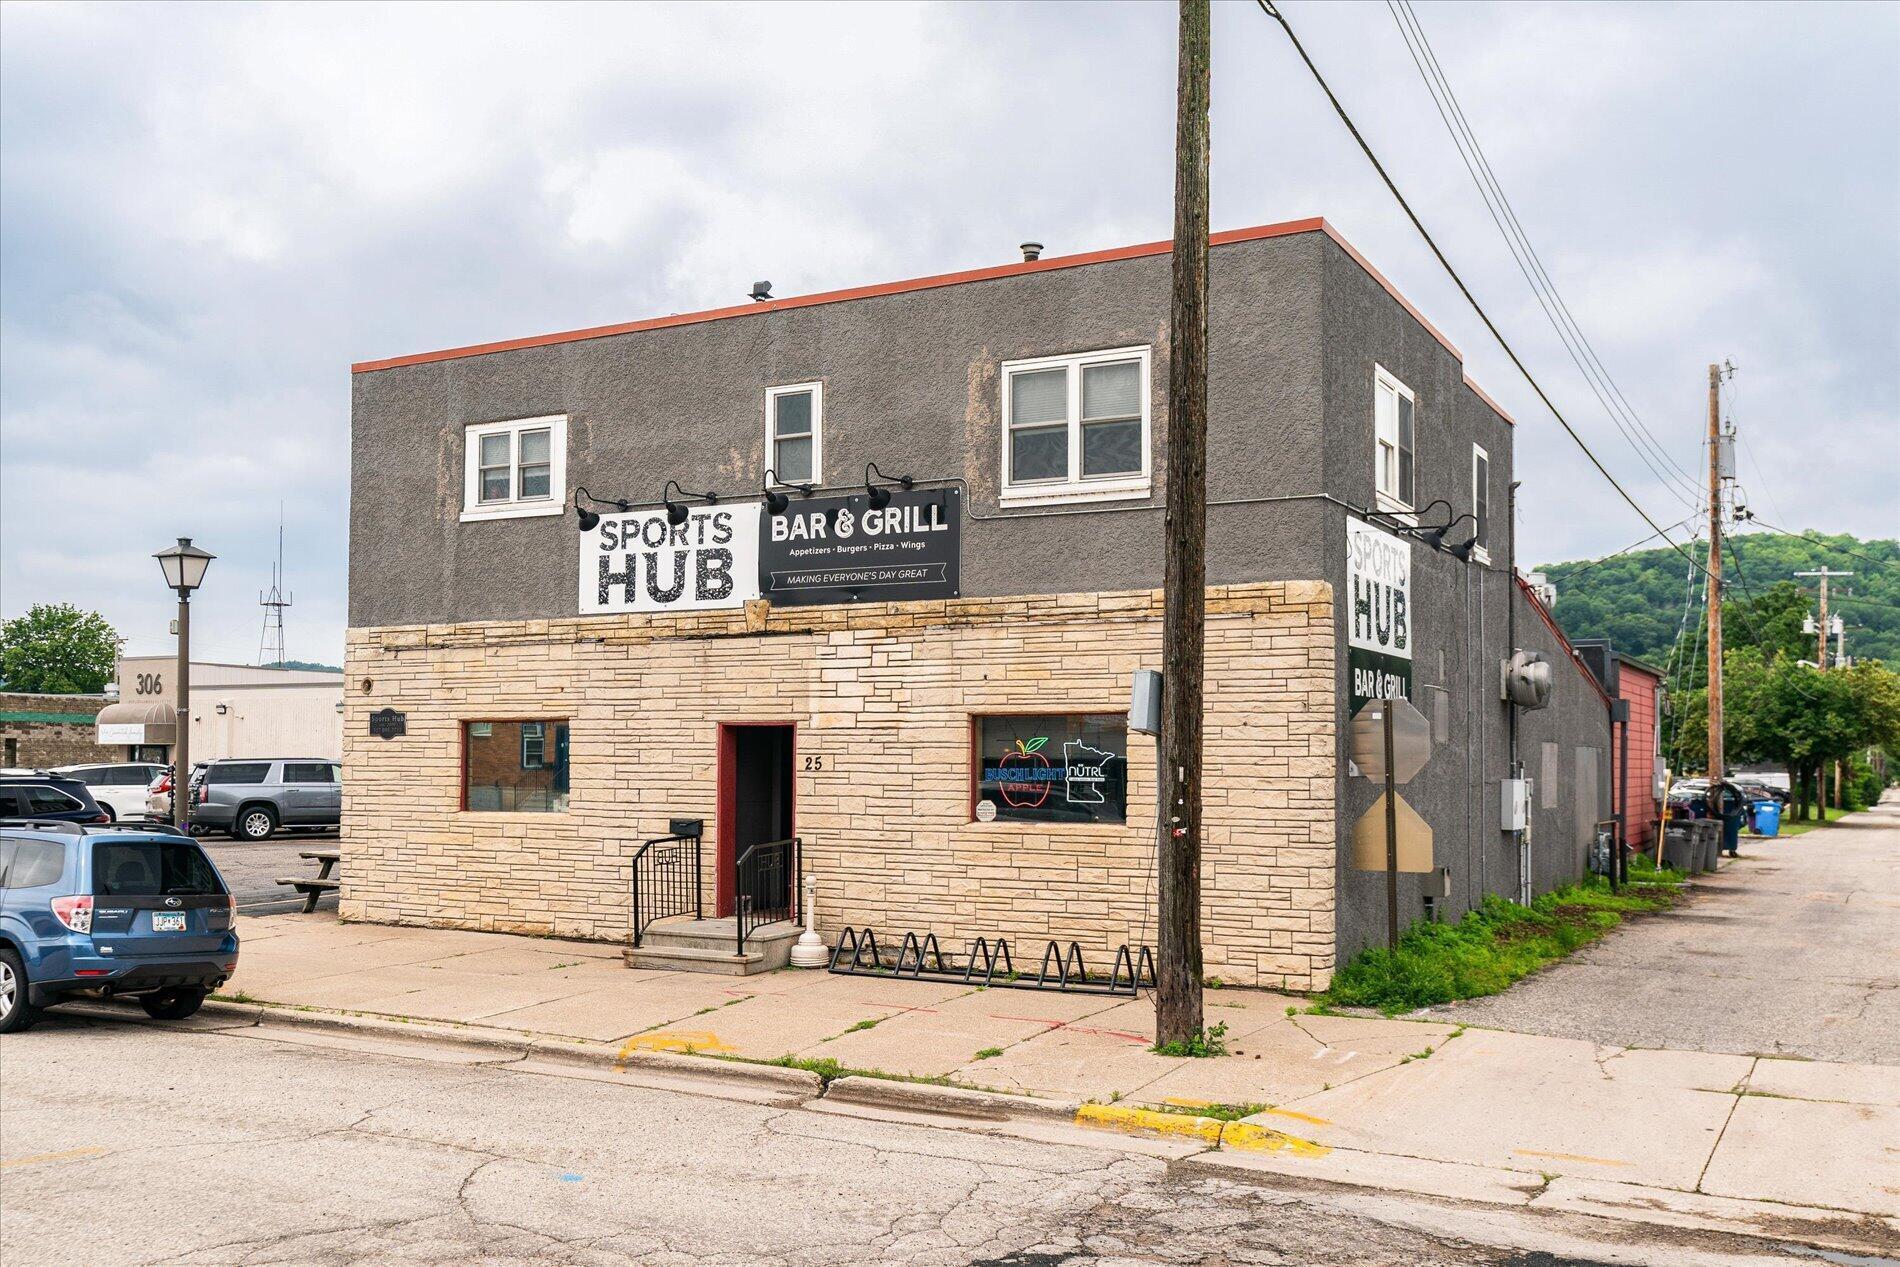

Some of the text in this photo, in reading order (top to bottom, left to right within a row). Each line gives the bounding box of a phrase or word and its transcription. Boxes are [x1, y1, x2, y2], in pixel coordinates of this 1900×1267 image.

[600, 512, 733, 551] SPORTS
[772, 504, 948, 541] BAR & GRILL
[789, 541, 926, 556] Appetizers Burgers Pizza Wings
[1354, 532, 1406, 587] SPORTS
[598, 548, 733, 605] HUB
[787, 568, 928, 584] MAKING EVERYONE'S DAY GREAT
[1354, 574, 1407, 650] HUB
[136, 673, 162, 695] 306
[1355, 668, 1408, 700] BAR & GRILL
[805, 756, 822, 770] 25
[985, 767, 1065, 781] BUSCH LIGHT
[1008, 783, 1044, 792] APPLE
